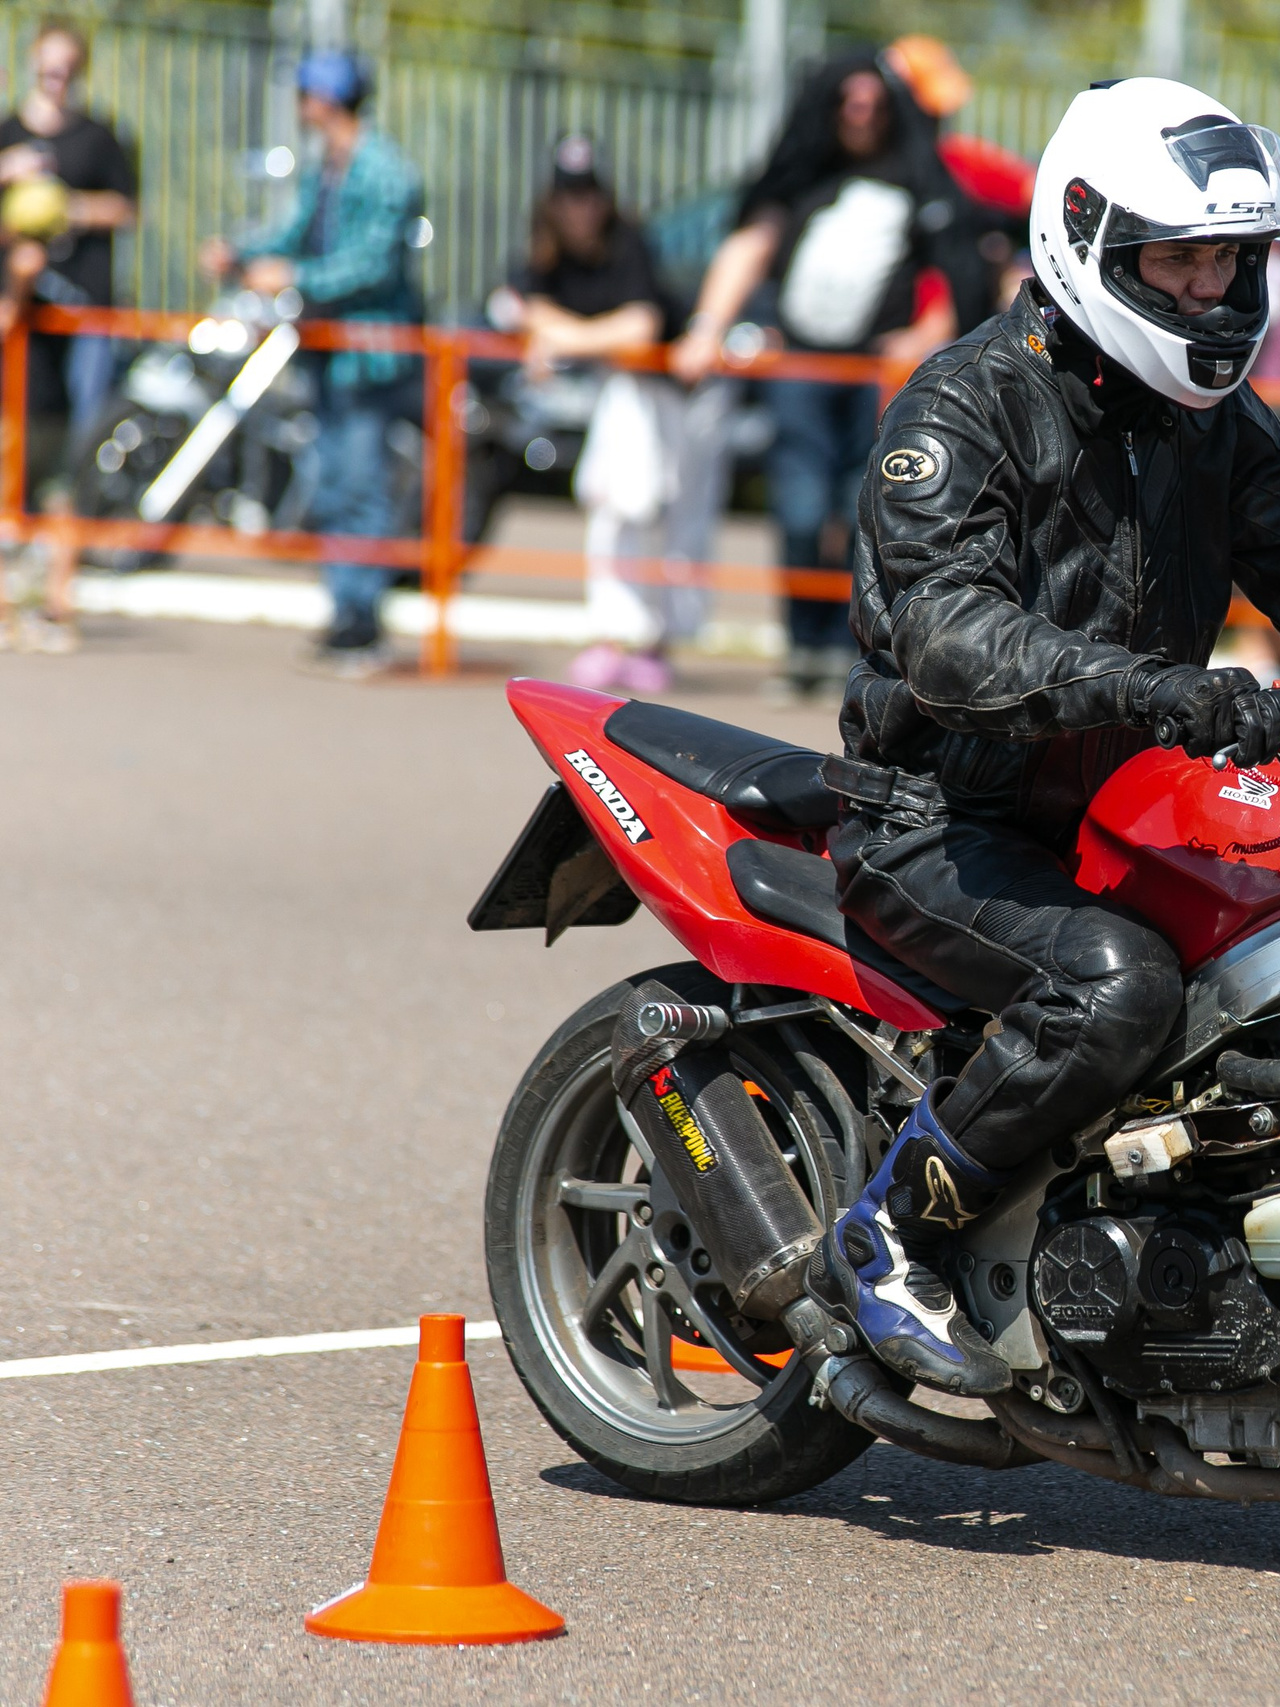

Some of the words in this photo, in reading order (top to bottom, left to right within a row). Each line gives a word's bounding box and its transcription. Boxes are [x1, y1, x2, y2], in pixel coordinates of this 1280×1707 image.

[563, 749, 646, 844] HONDA
[1222, 788, 1268, 807] HONDA
[1050, 1304, 1115, 1320] HONDA
